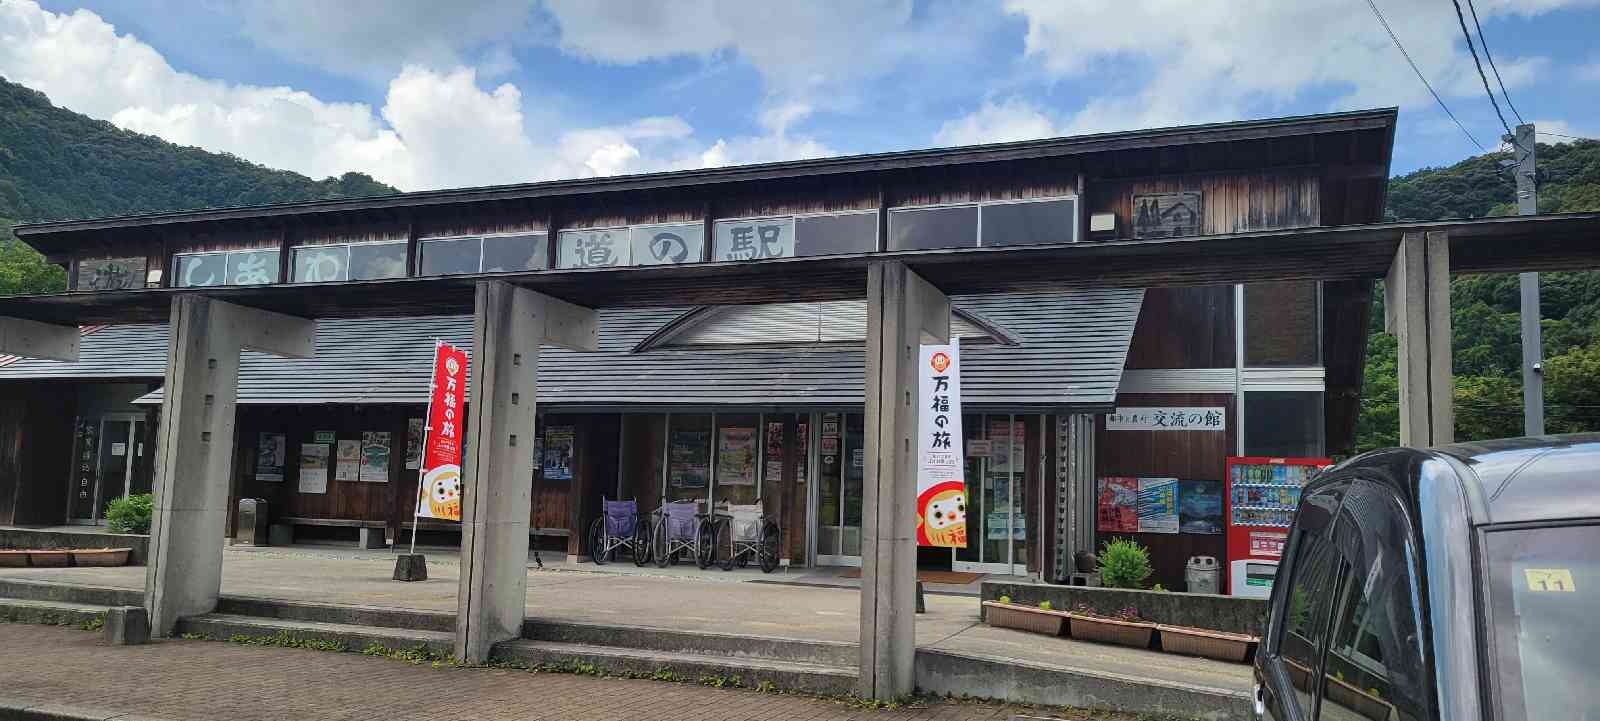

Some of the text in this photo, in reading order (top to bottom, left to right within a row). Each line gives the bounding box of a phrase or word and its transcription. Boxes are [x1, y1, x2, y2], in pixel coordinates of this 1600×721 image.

[574, 225, 784, 267] 道の駅
[441, 375, 457, 439] 万福の旅
[930, 376, 952, 449] 万福の旅
[1152, 410, 1223, 427] 交流の館
